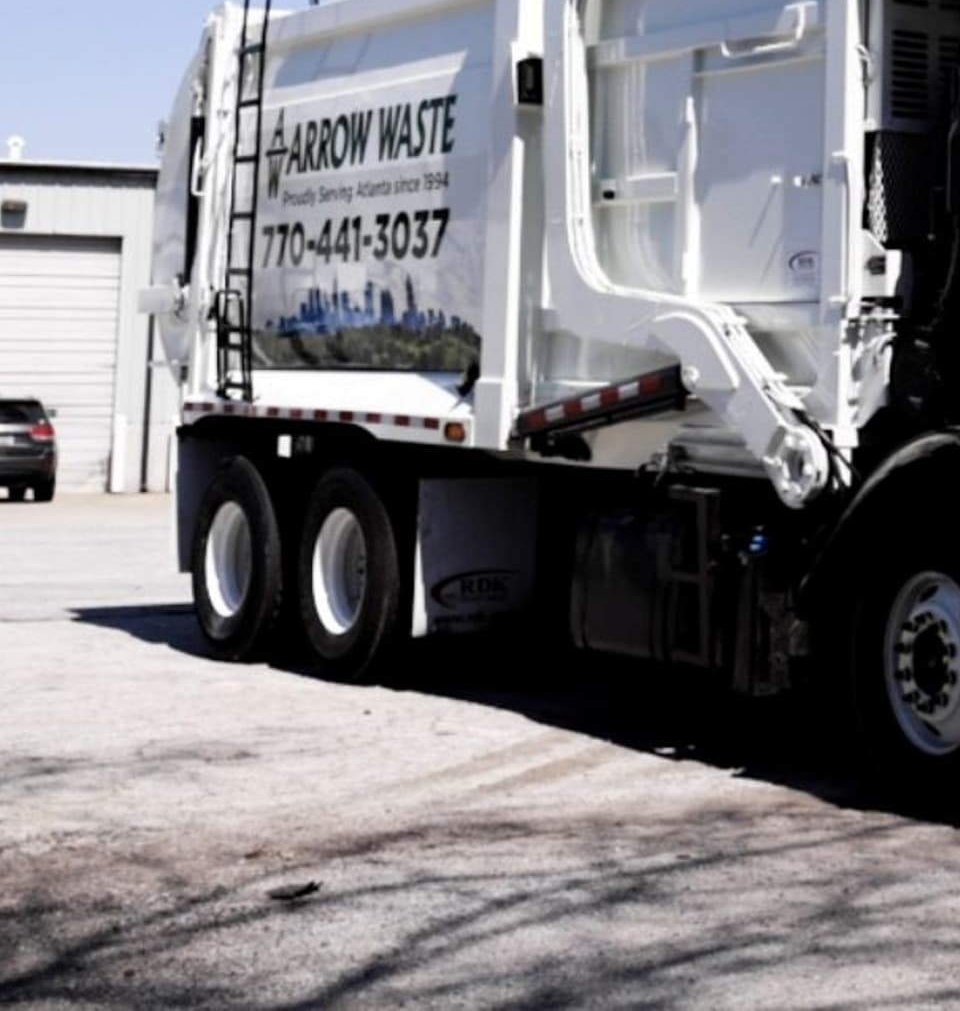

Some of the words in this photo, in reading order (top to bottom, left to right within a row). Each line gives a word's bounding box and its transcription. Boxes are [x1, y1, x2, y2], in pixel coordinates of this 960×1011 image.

[286, 109, 373, 175] ARROW
[378, 94, 457, 161] WASTE
[283, 185, 316, 207] Proudly
[318, 185, 353, 205] Serving
[356, 179, 393, 198] Atlanta
[262, 207, 450, 269] 770-441-3037
